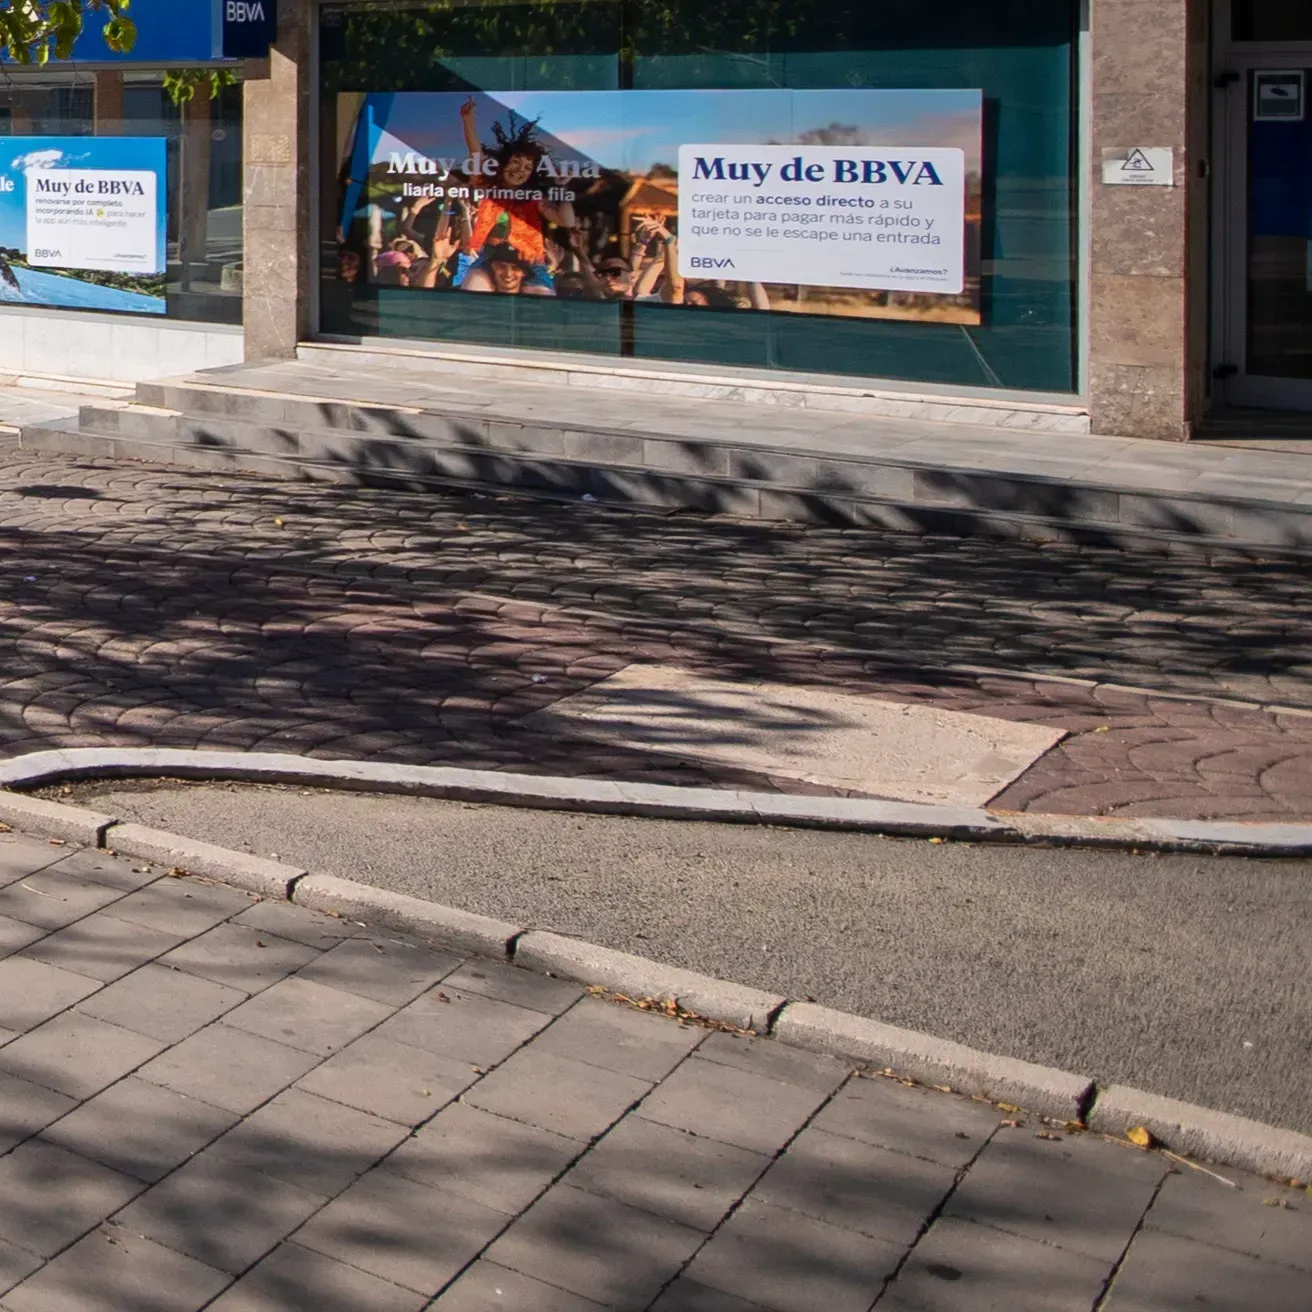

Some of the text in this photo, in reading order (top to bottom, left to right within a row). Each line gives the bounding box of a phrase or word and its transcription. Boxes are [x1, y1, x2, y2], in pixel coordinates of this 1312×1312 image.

[226, 0, 265, 22] BBVA
[387, 152, 602, 180] Muy de Ana
[691, 157, 944, 187] Muy de BBVA
[36, 179, 145, 196] Muy de BBVA
[403, 183, 575, 202] liarla en primera fila
[72, 199, 85, 207] por
[87, 200, 123, 208] completo
[691, 192, 913, 210] crear un acceso directo a su
[691, 208, 935, 230] tarjeta para pagar más rápido y
[691, 225, 941, 245] que no se le escape una entrada
[34, 248, 63, 258] BBVA
[690, 256, 736, 269] BBVA
